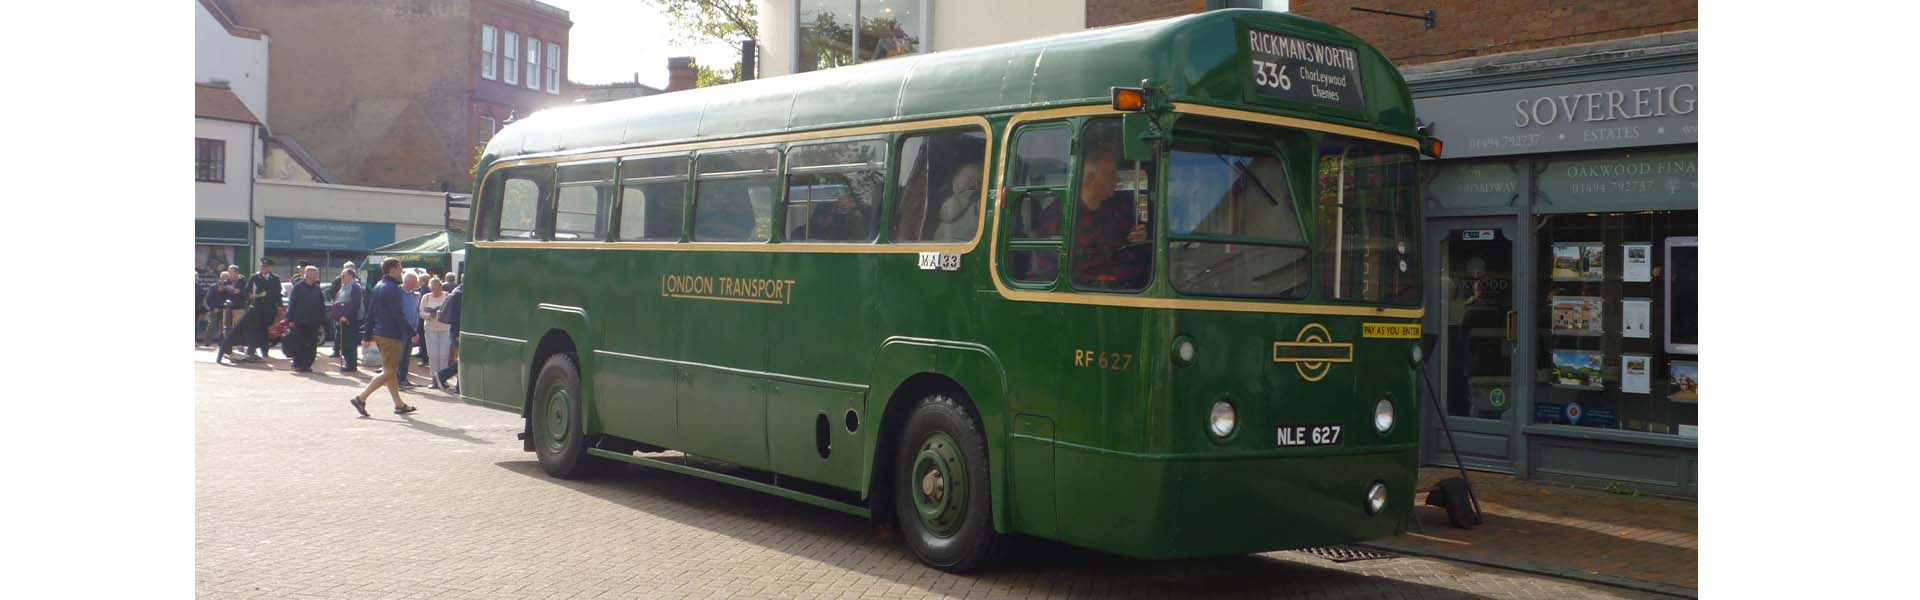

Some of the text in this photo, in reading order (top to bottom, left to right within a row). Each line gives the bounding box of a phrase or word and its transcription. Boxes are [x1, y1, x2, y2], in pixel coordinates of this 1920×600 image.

[1250, 30, 1354, 70] RICKMANSWORTH
[1252, 60, 1291, 90] 336
[1515, 84, 1697, 128] SOVEREIG
[1584, 126, 1640, 142] ESTATES
[1567, 163, 1650, 178] OAKWOOD
[943, 254, 957, 268] 33
[662, 274, 796, 305] LONDON TRANSPORT
[1365, 326, 1420, 337] PAY AS YOU ENTER
[1075, 349, 1133, 371] RF 627
[1277, 426, 1341, 445] NLE 627
